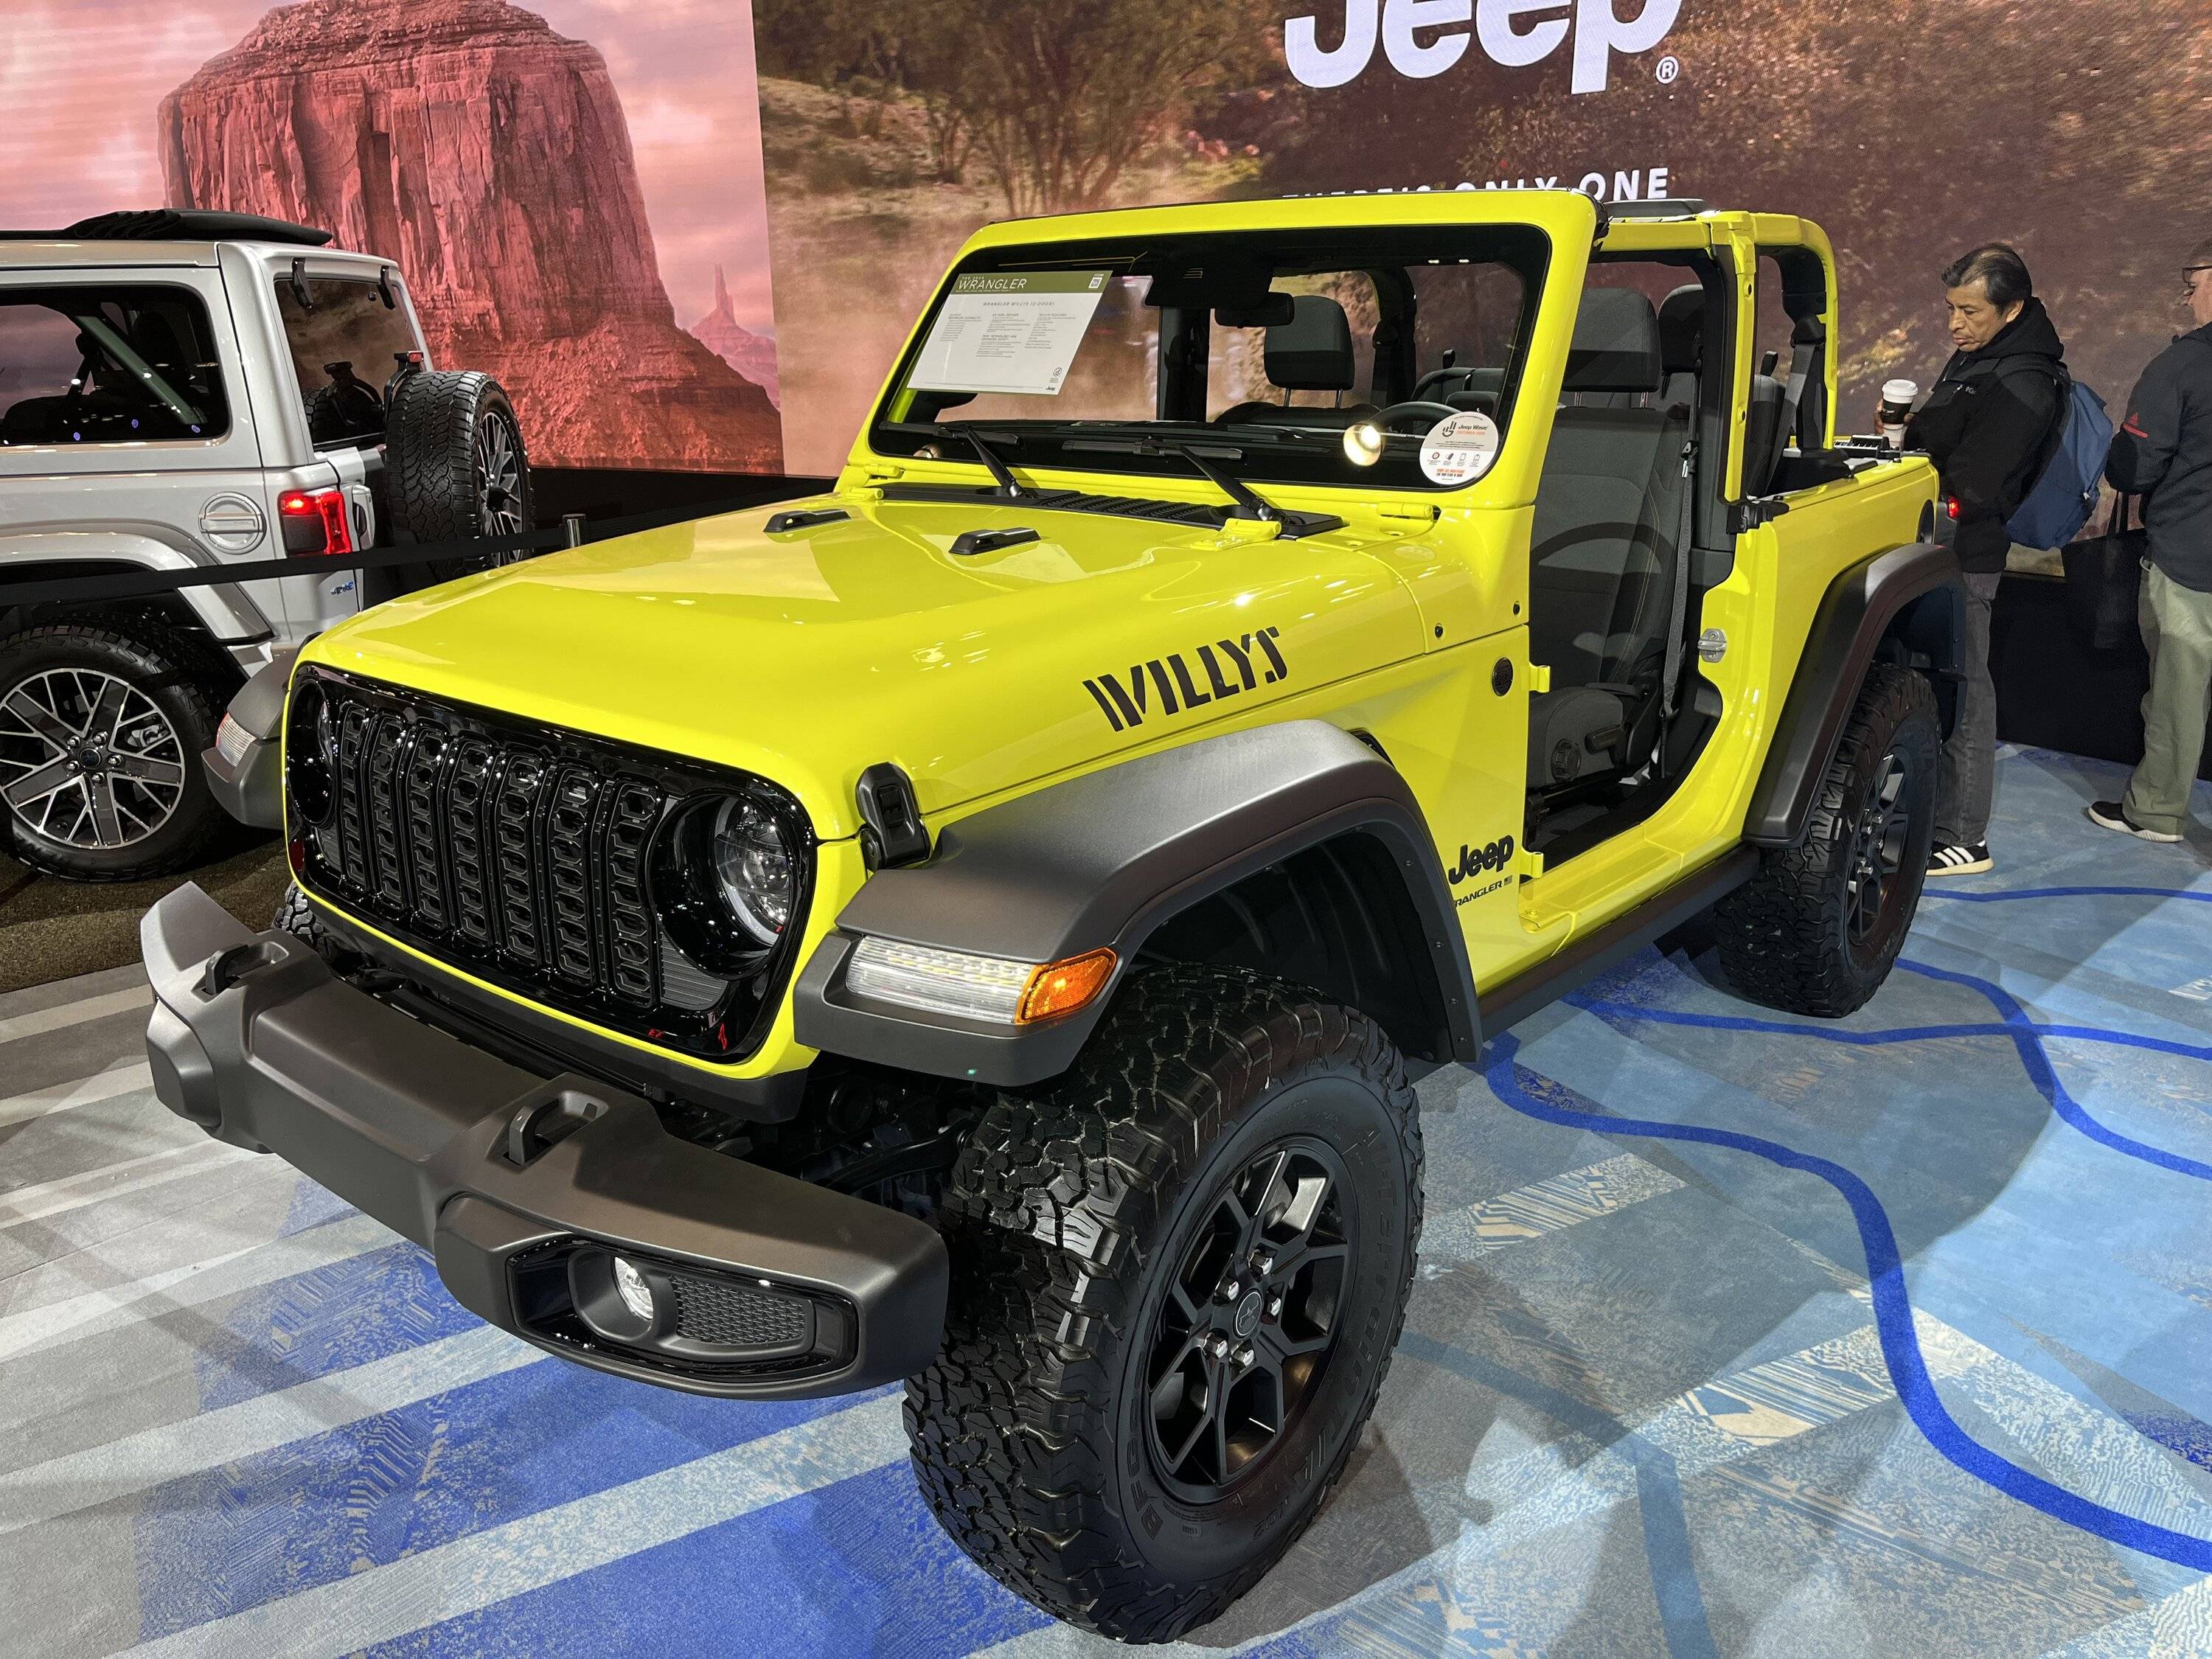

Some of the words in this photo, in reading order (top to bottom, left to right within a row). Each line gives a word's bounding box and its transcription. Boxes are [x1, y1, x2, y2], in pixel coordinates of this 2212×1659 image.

[1284, 0, 1683, 94] Jeep
[958, 279, 1027, 291] WRANGLER
[1082, 626, 1288, 732] WILLYS
[1448, 835, 1514, 885] Jeep
[1454, 880, 1503, 908] RANGLER
